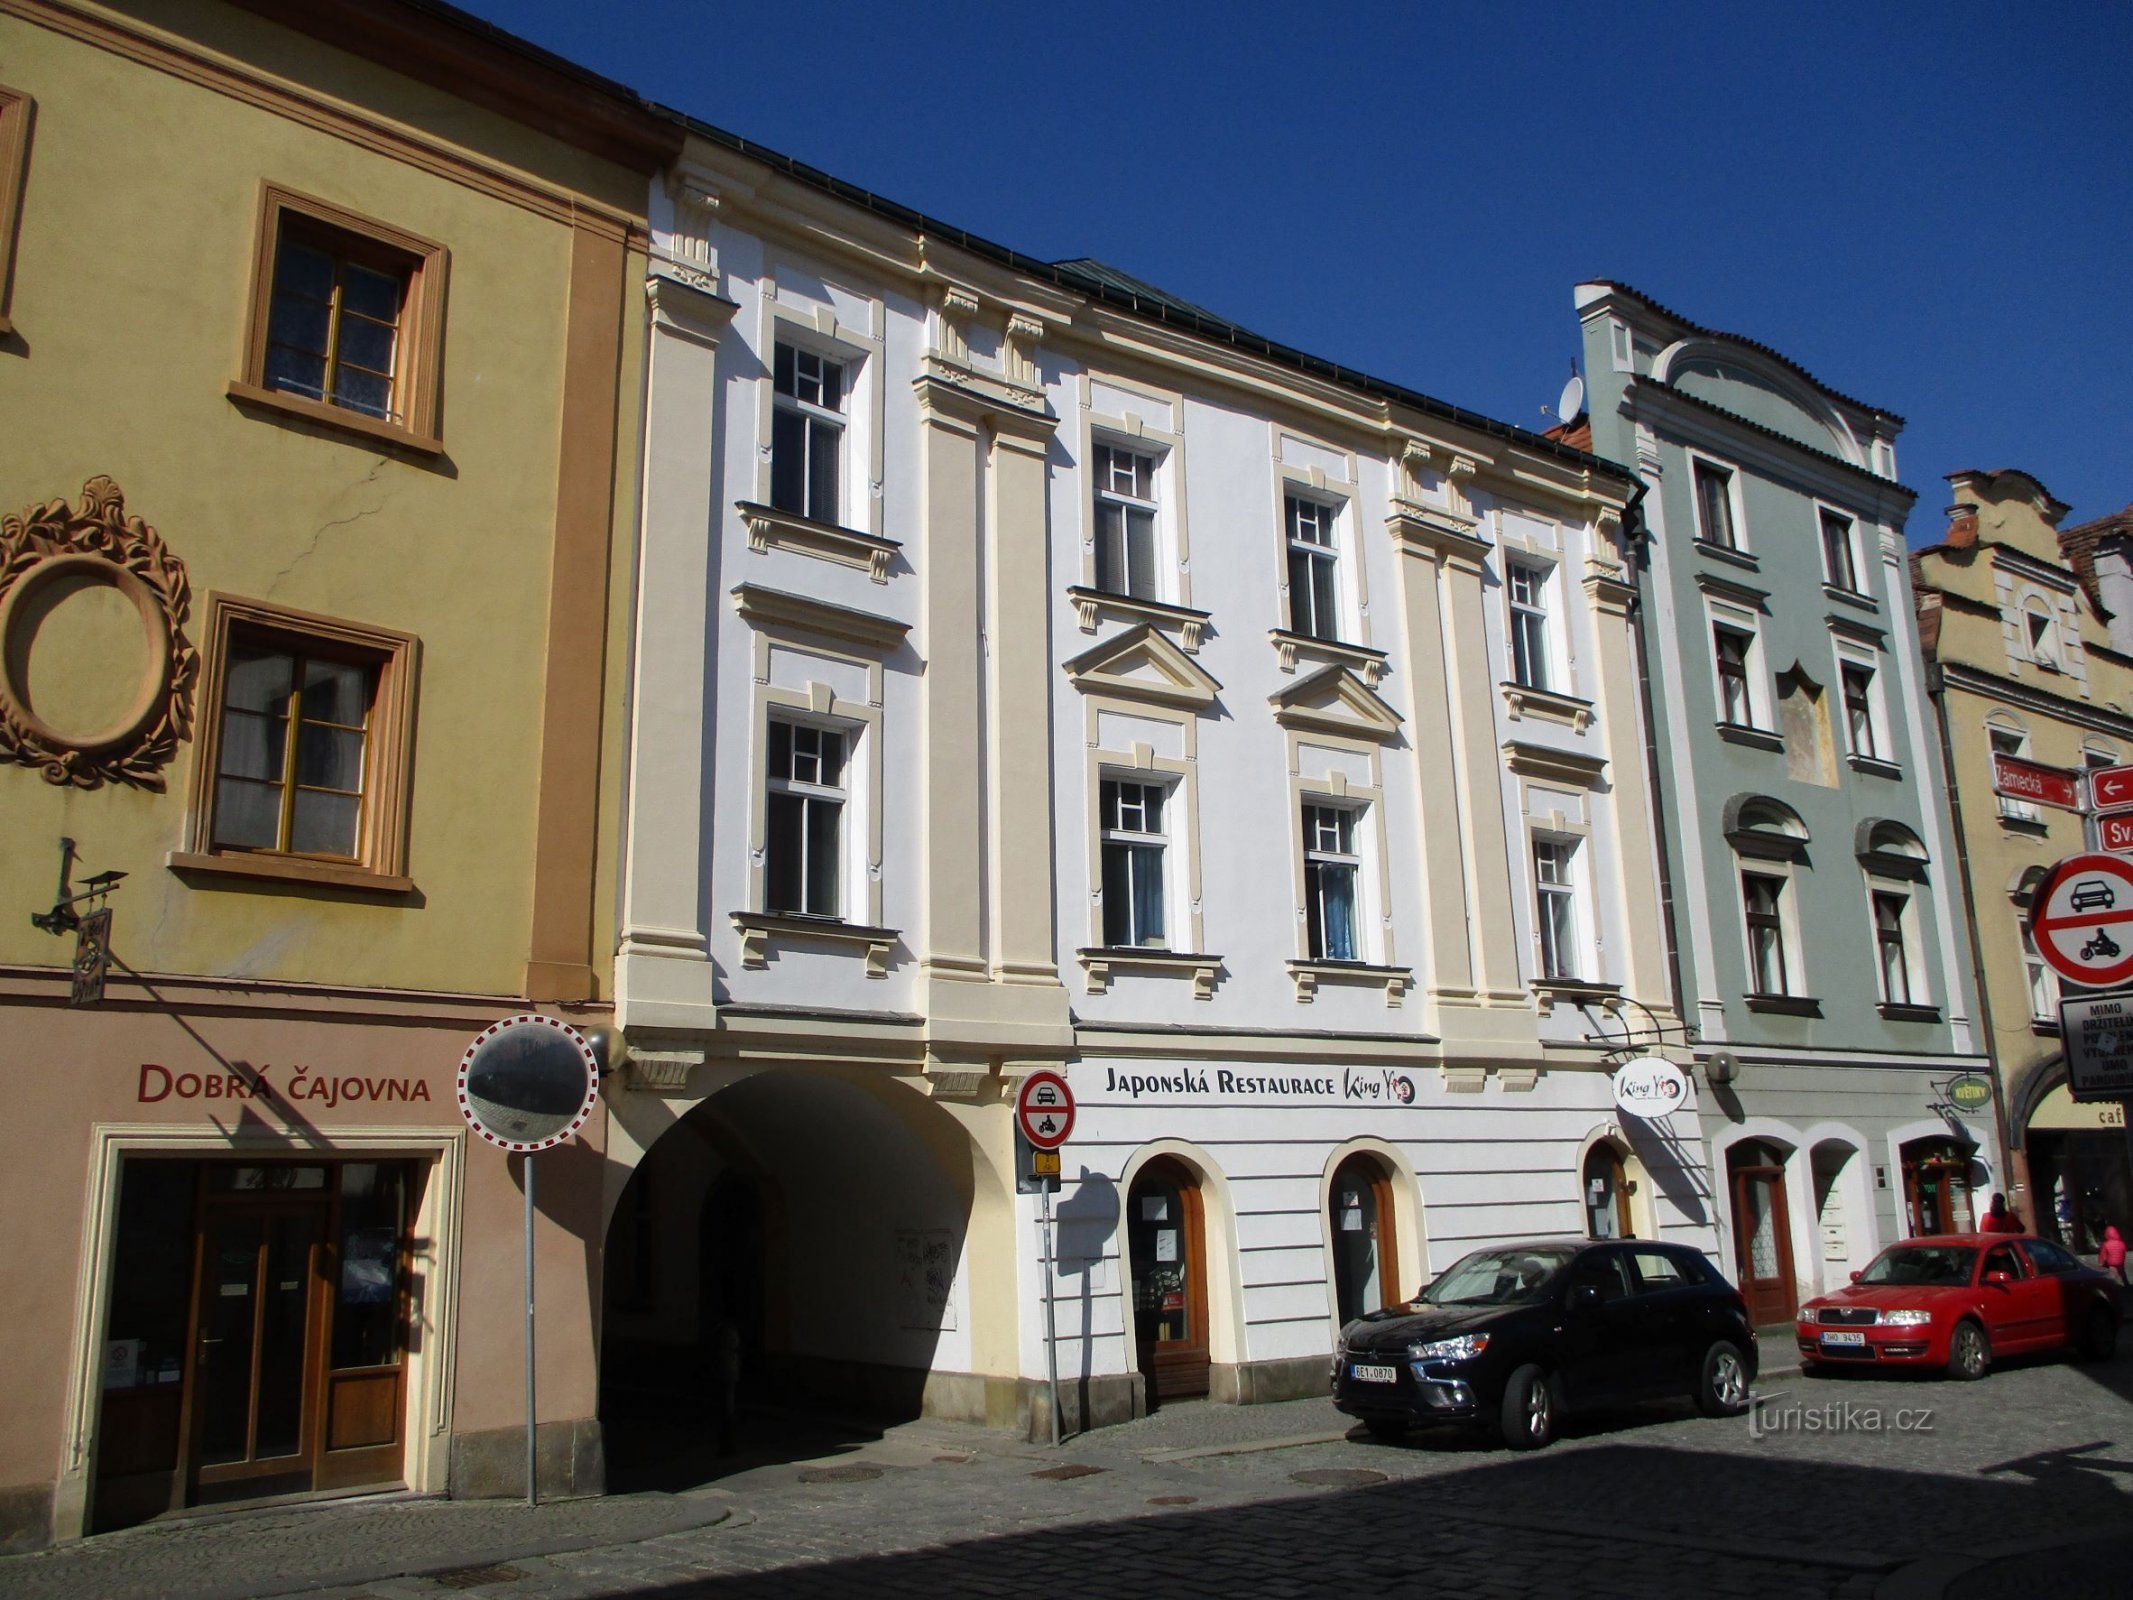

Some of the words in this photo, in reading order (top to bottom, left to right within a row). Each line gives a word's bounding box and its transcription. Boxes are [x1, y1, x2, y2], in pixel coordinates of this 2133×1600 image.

[1996, 764, 2042, 794] Zámecká
[2110, 822, 2133, 843] Sv.
[2089, 1003, 2122, 1016] MIMO
[1343, 1067, 1380, 1100] King
[1620, 1075, 1650, 1098] King
